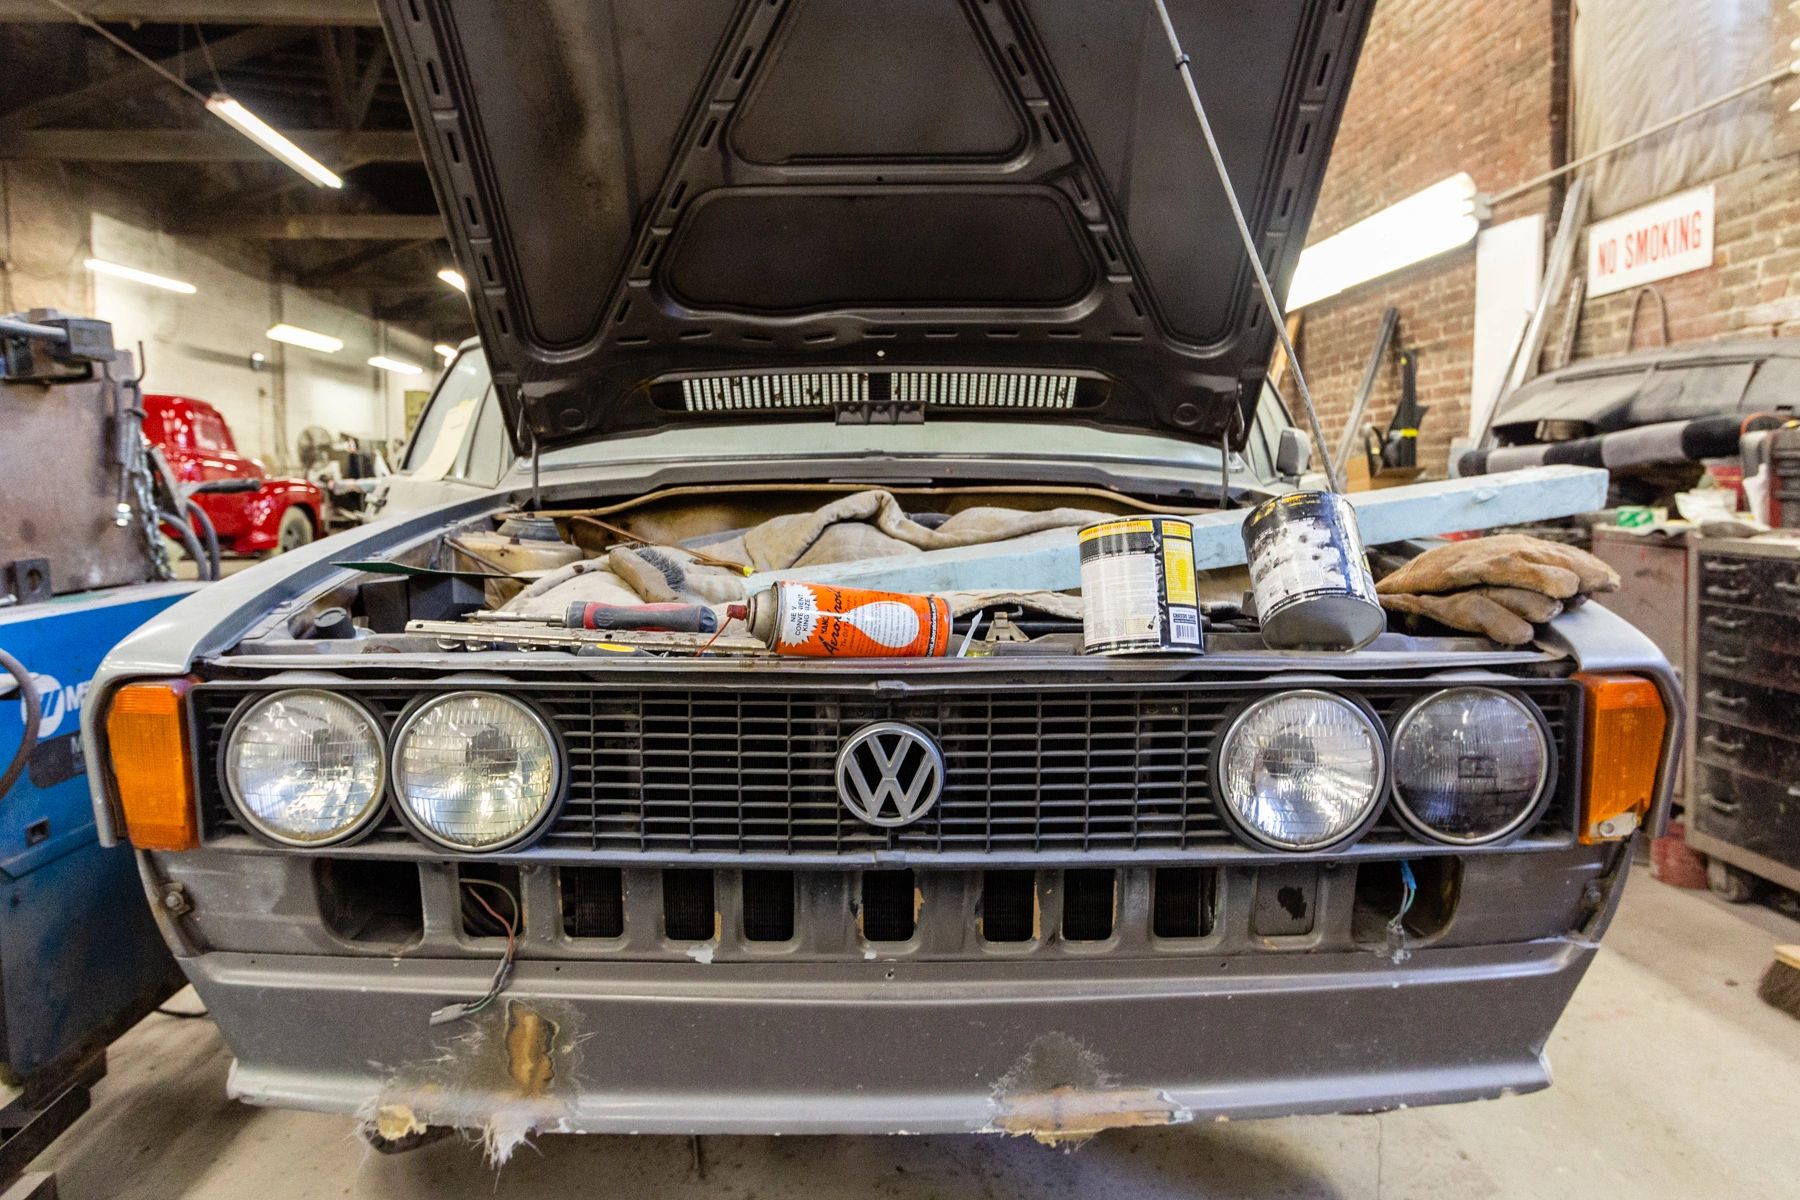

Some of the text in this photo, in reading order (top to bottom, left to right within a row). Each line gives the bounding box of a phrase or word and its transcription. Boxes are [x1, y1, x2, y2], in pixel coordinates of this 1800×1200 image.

[1598, 210, 1702, 277] NO SMOKING
[838, 722, 944, 827] VW
